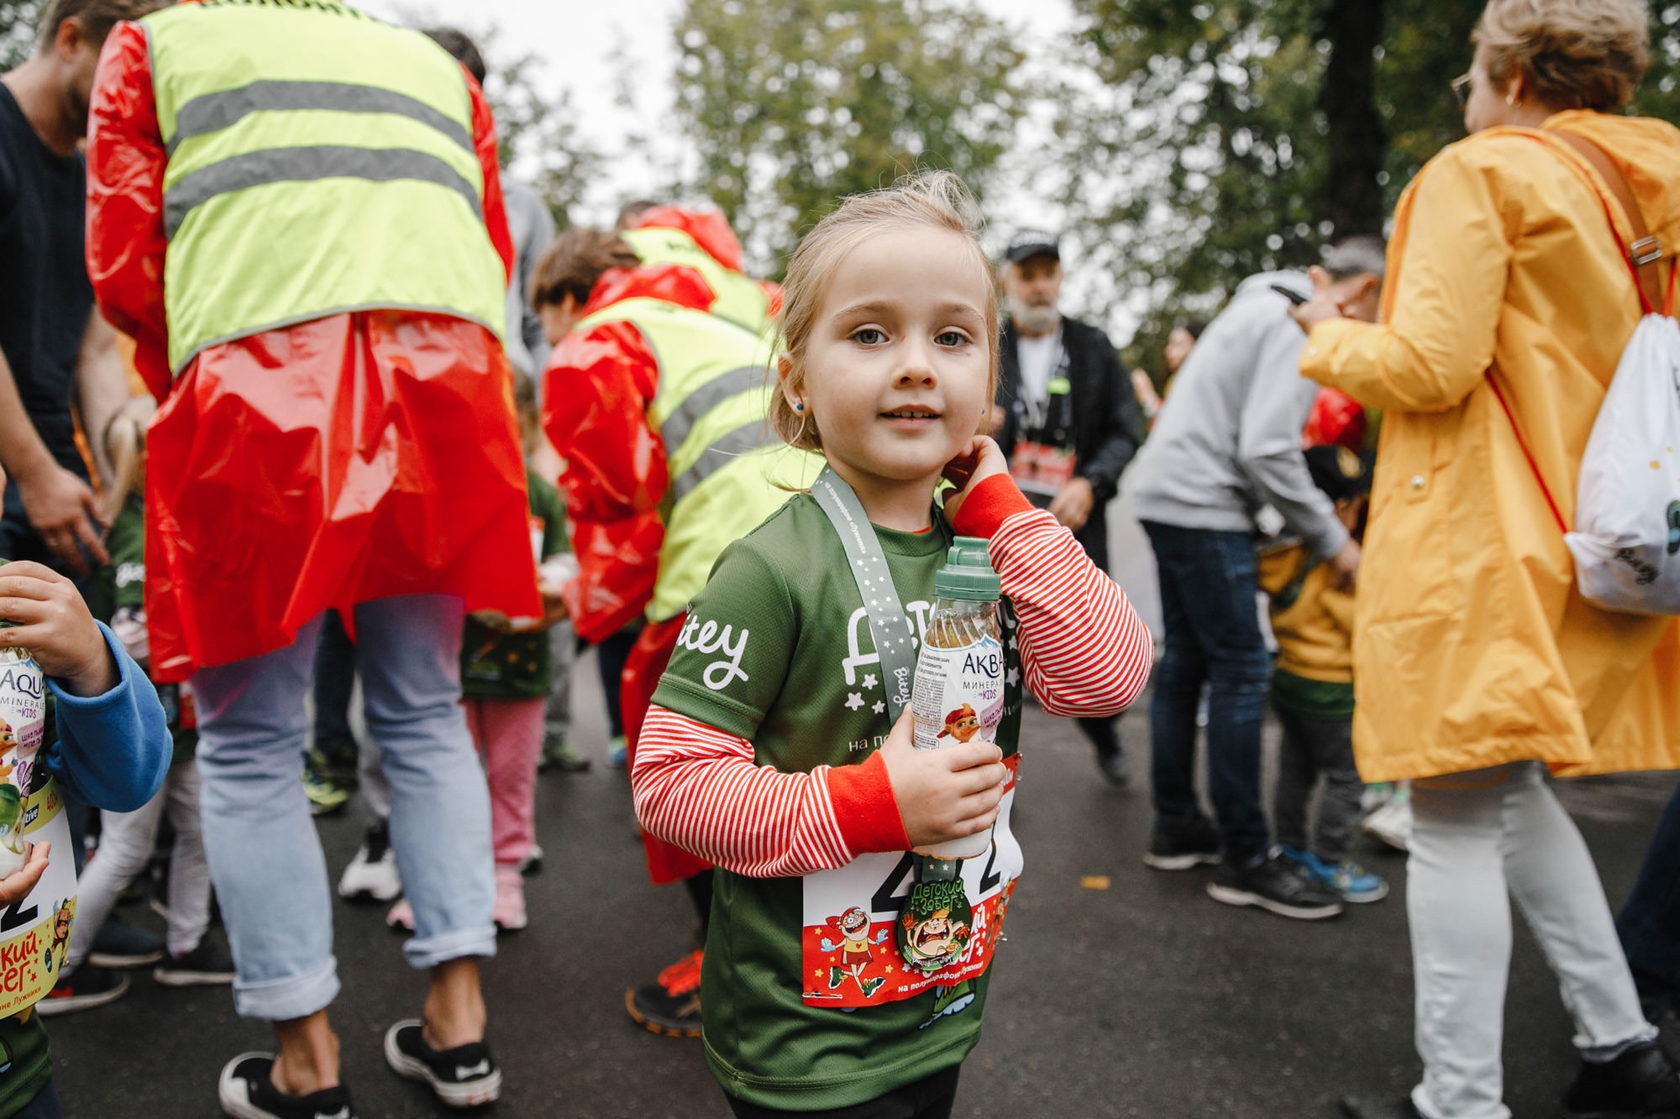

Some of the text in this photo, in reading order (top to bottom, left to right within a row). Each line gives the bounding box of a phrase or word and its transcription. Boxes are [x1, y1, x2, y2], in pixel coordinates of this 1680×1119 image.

[0, 669, 45, 699] AQU
[21, 708, 37, 719] KIDS
[849, 738, 868, 752] на
[25, 808, 38, 823] tive
[912, 880, 965, 900] Детский
